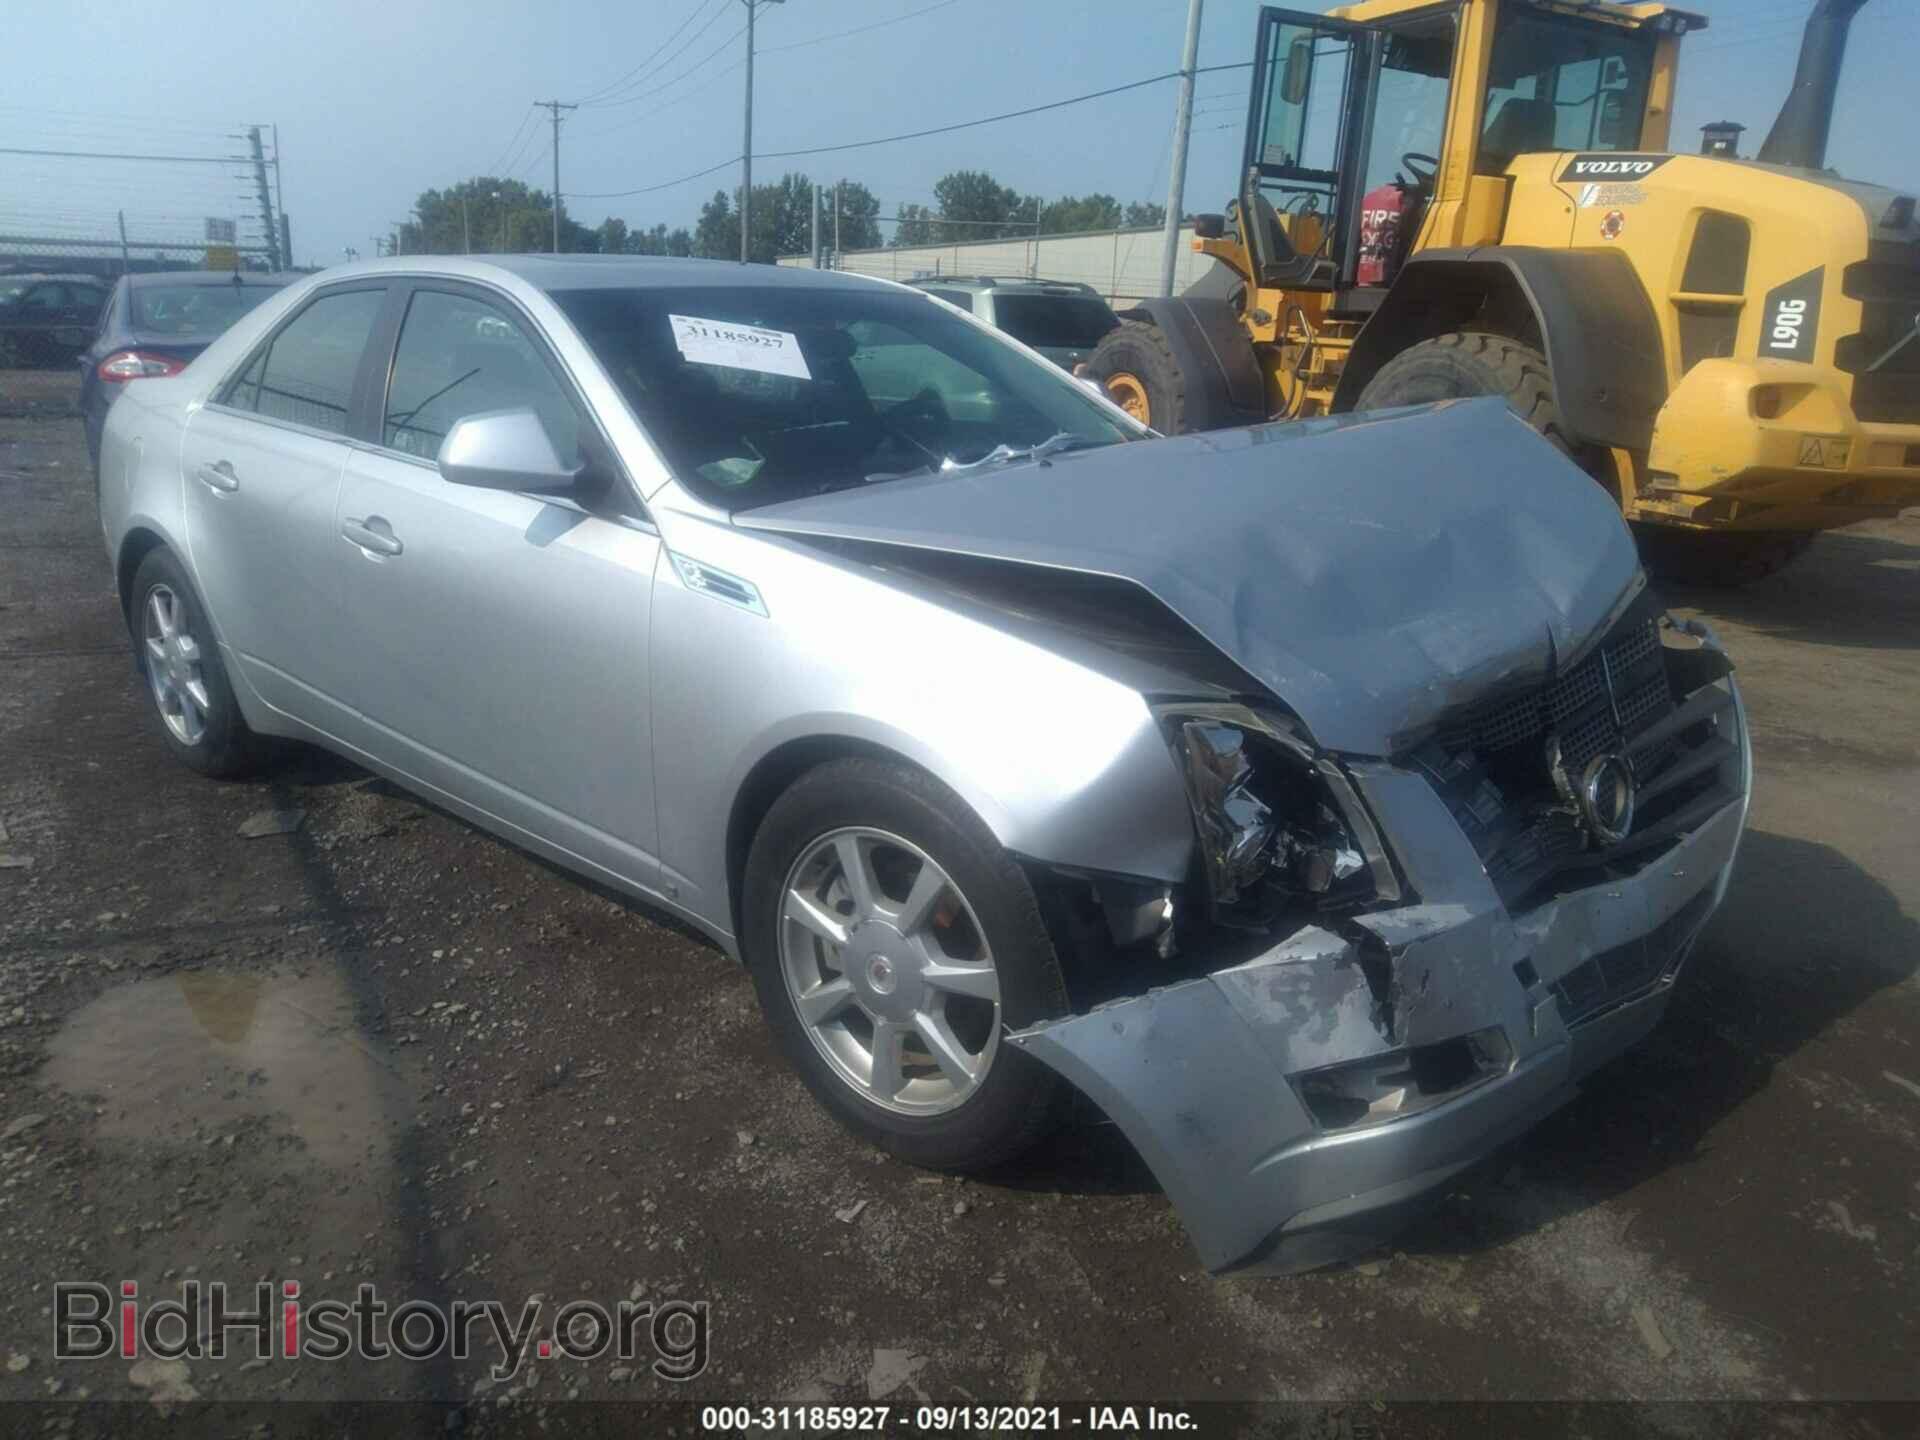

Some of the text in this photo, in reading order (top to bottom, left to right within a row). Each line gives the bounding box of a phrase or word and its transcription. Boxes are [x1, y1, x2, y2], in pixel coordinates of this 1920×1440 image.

[1575, 161, 1654, 173] VOLVO
[1361, 209, 1400, 228] FIRE
[1770, 299, 1807, 349] L90G
[686, 325, 783, 349] 31185927
